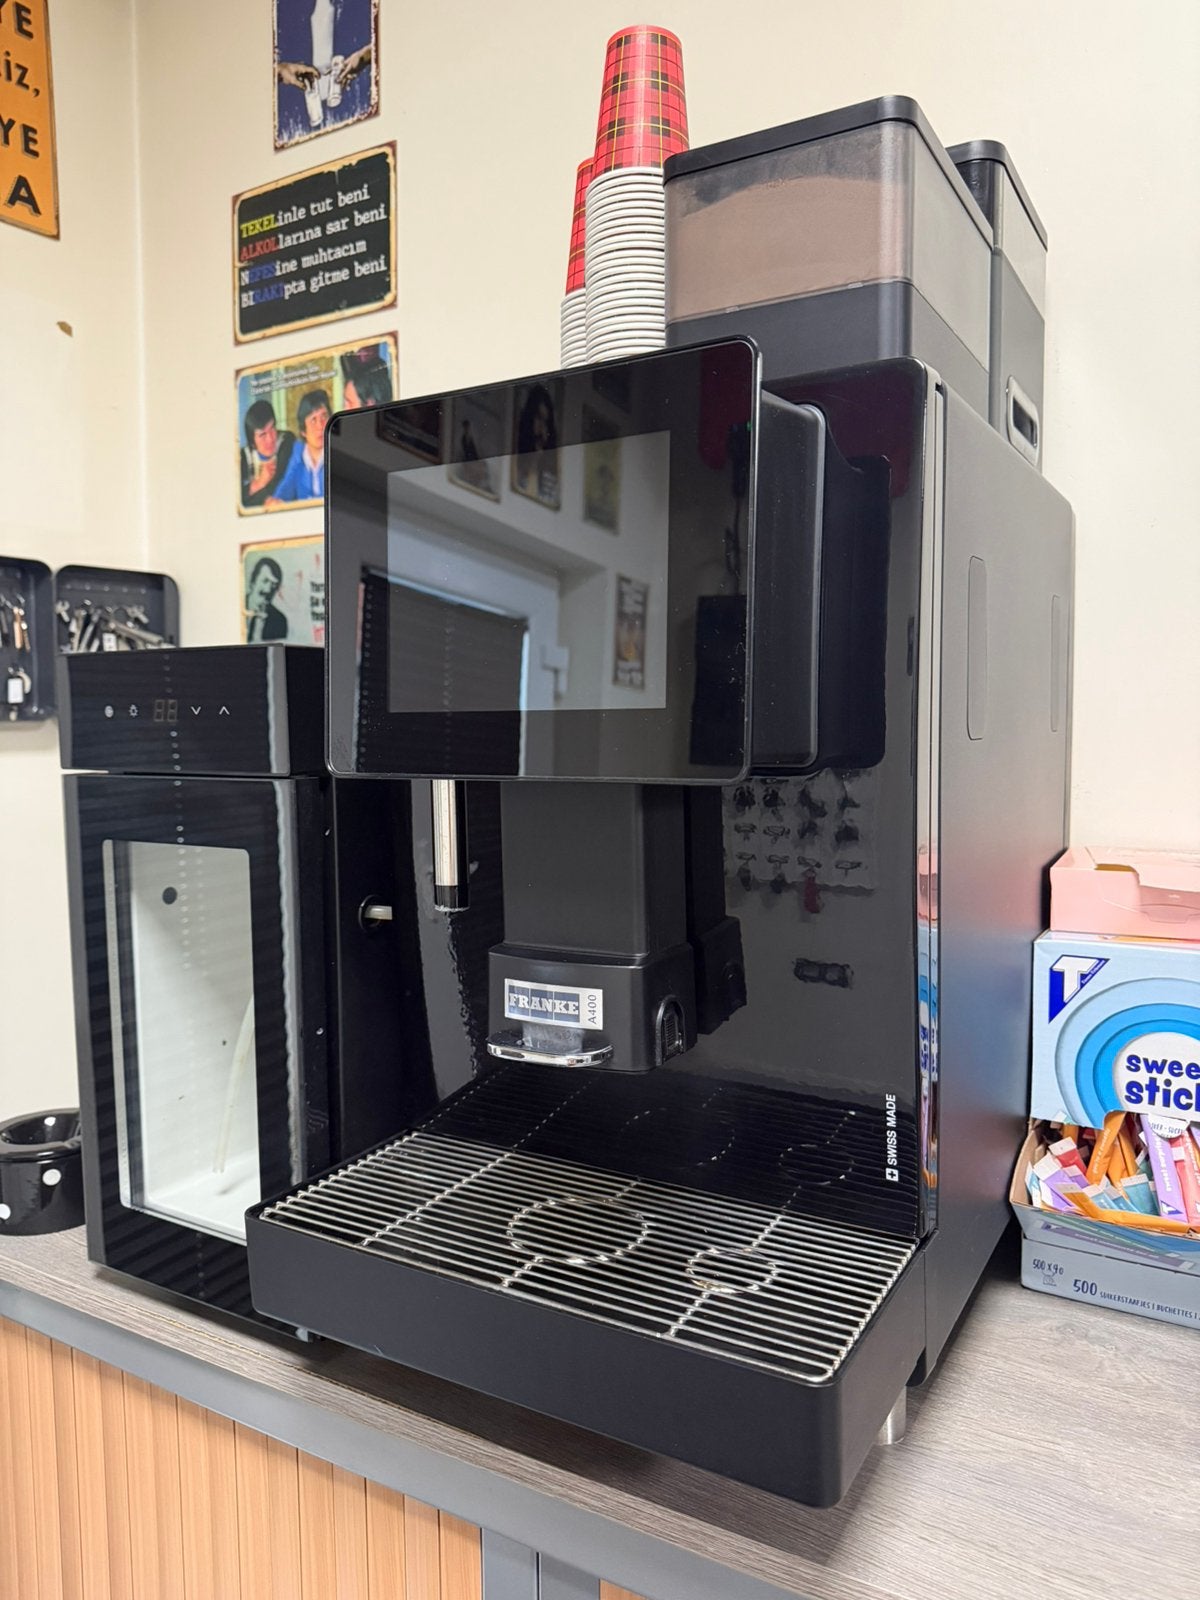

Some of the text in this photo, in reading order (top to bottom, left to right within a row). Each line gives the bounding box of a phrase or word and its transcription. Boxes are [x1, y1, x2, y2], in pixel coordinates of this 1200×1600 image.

[0, 51, 41, 98] iz,
[5, 174, 42, 216] A
[240, 183, 371, 238] TEKELinle tut beni
[325, 217, 350, 235] sar
[353, 202, 387, 227] beni
[310, 268, 350, 293] gitme
[353, 254, 387, 277] beni
[508, 993, 579, 1015] FRANKE
[587, 994, 597, 1025] A400
[885, 1093, 897, 1166] SWISS MADE
[1073, 1279, 1098, 1296] 500
